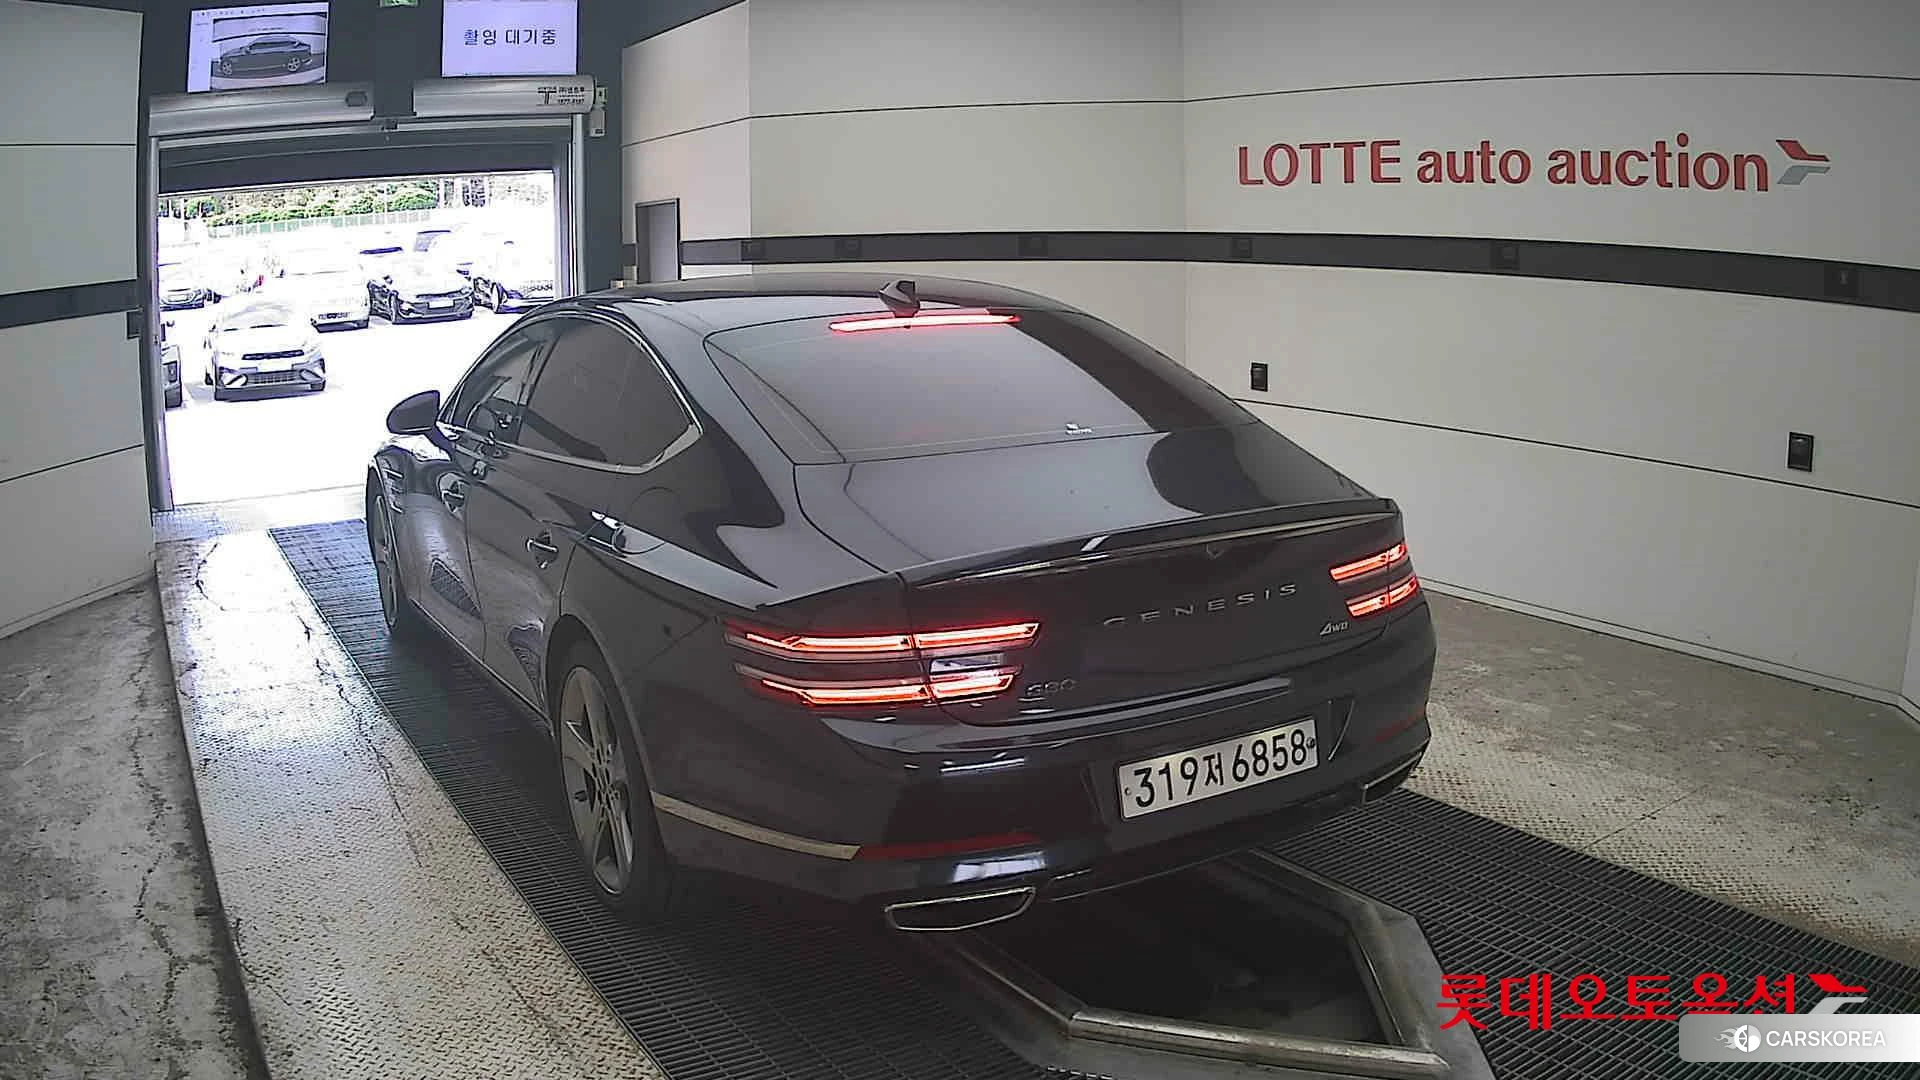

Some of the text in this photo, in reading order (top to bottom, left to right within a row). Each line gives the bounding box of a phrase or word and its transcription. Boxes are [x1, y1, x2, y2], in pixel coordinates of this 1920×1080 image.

[505, 29, 557, 46] 대기중
[1239, 132, 1769, 192] LOTTE auto auction
[1134, 729, 1307, 808] 319저 6858
